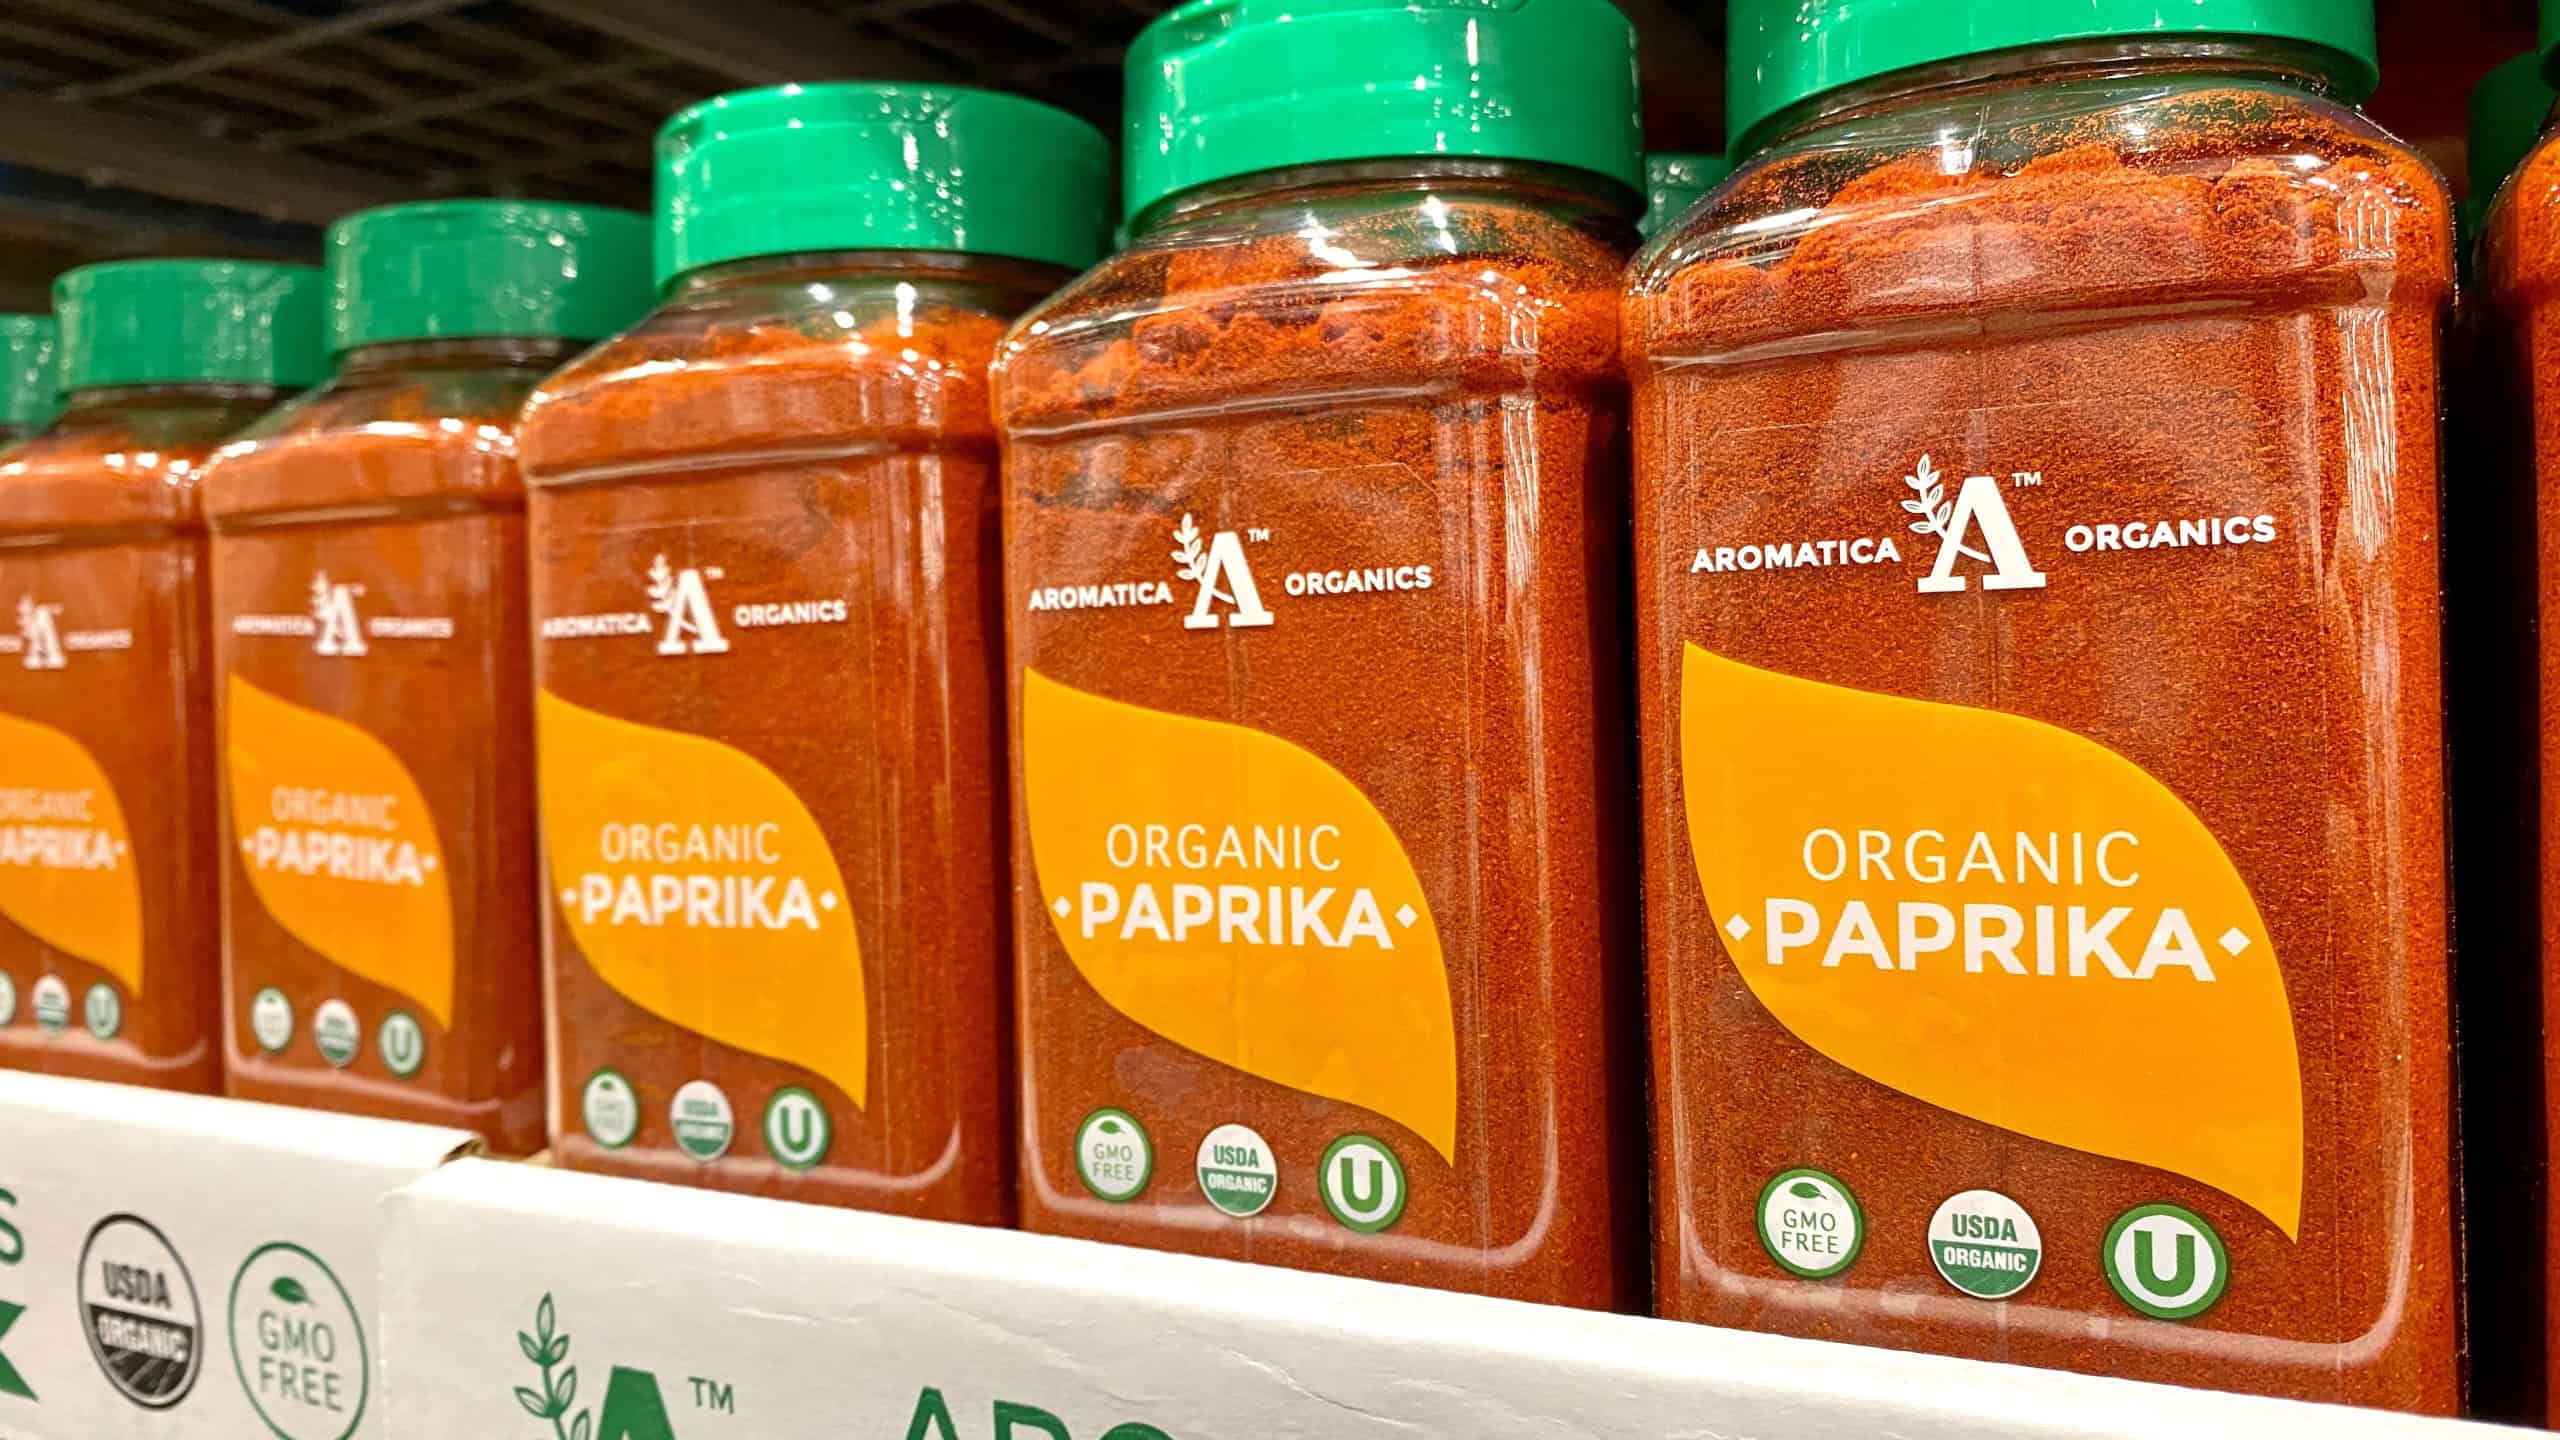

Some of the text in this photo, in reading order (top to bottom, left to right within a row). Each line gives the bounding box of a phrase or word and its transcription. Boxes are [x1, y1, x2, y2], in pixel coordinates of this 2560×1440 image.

[1691, 538, 1901, 574] AROMATICA
[2064, 514, 2276, 552] ORGANICS
[1029, 582, 1174, 611] AROMATICA
[1284, 564, 1433, 596] ORGANICS
[541, 612, 652, 639] AROMATICA
[734, 599, 848, 627] ORGANICS
[271, 785, 397, 831] ORGANIC
[0, 825, 117, 869] APRIKA
[256, 825, 424, 887] PAPRIKA
[600, 821, 780, 864] ORGANIC
[1106, 823, 1341, 872] ORGANIC
[1803, 828, 2140, 888] ORGANIC
[580, 873, 820, 930] PAPRIKA
[1081, 881, 1394, 950] PAPRIKA
[1765, 898, 2216, 982] PAPRIKA
[779, 1105, 812, 1153] U
[1093, 1143, 1133, 1162] GMO
[1093, 1161, 1136, 1182] FREE
[1213, 1144, 1260, 1169] USDA
[1207, 1171, 1268, 1195] ORGANIC
[1340, 1157, 1383, 1213] U
[1780, 1231, 1840, 1255] FREE
[1782, 1208, 1837, 1233] GMO
[1951, 1213, 2019, 1243] USDA
[1943, 1246, 2028, 1274] ORGANIC
[2132, 1229, 2196, 1298] U
[101, 1260, 171, 1309] USDA
[258, 1309, 337, 1363] GMO
[259, 1355, 344, 1413] FREE
